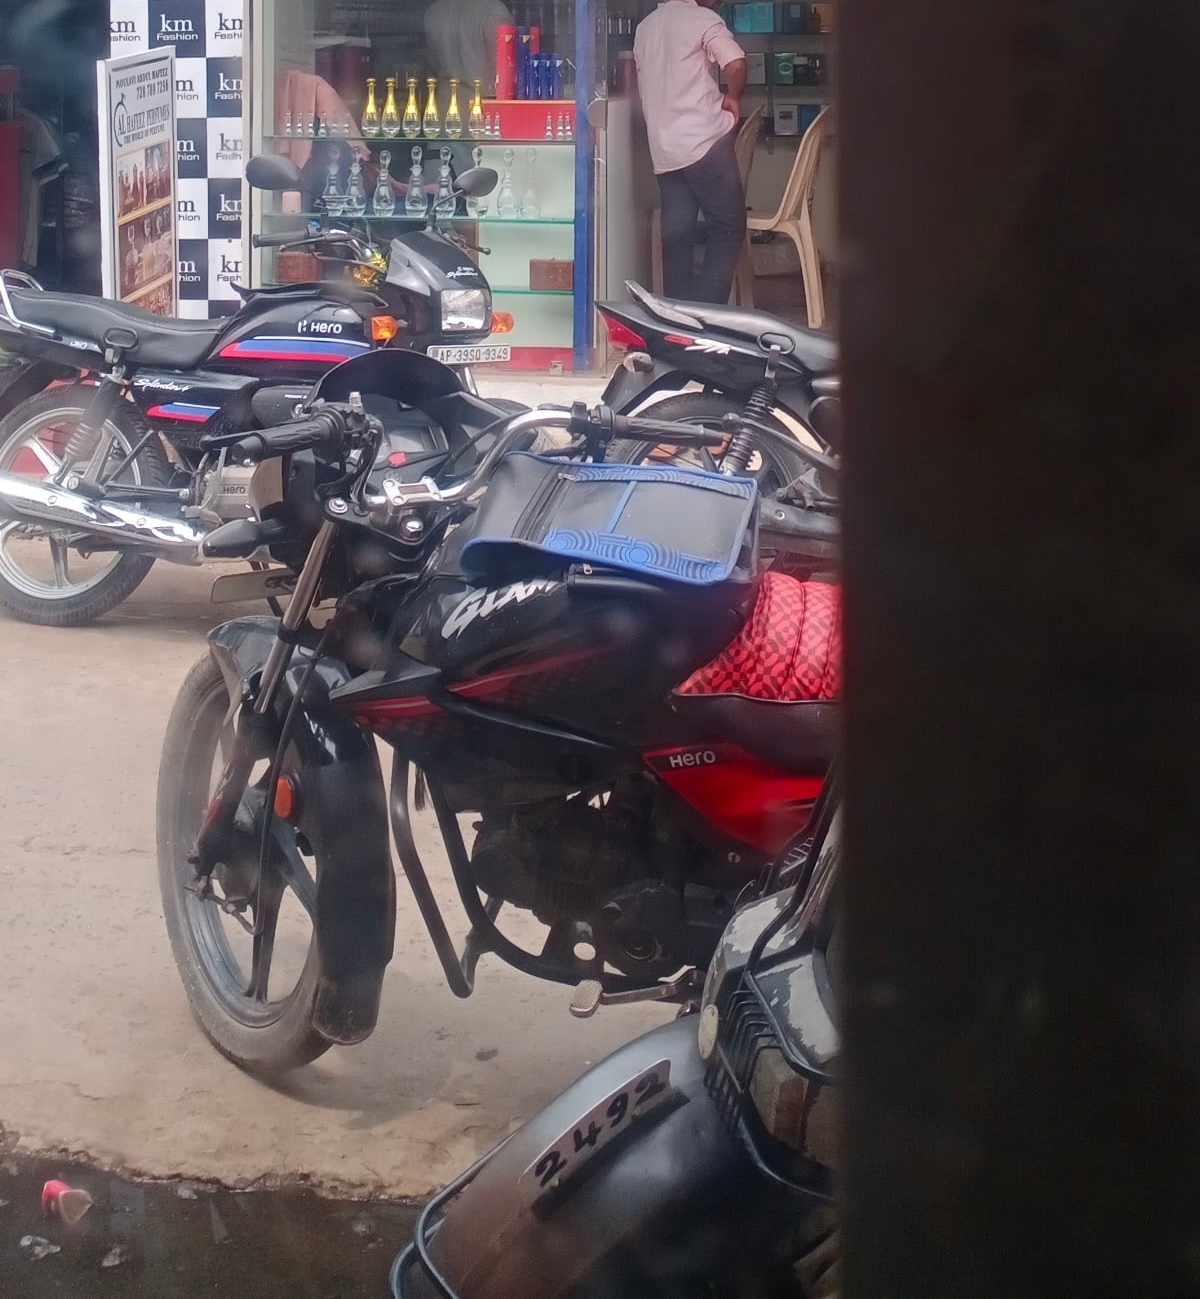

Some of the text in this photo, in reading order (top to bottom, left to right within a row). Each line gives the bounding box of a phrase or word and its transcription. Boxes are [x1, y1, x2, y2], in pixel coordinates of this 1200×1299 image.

[160, 13, 194, 32] km
[157, 32, 198, 41] Fashion
[310, 321, 342, 334] Hero
[222, 486, 246, 494] Hero
[669, 750, 716, 768] Hero
[534, 1072, 666, 1189] 2492
